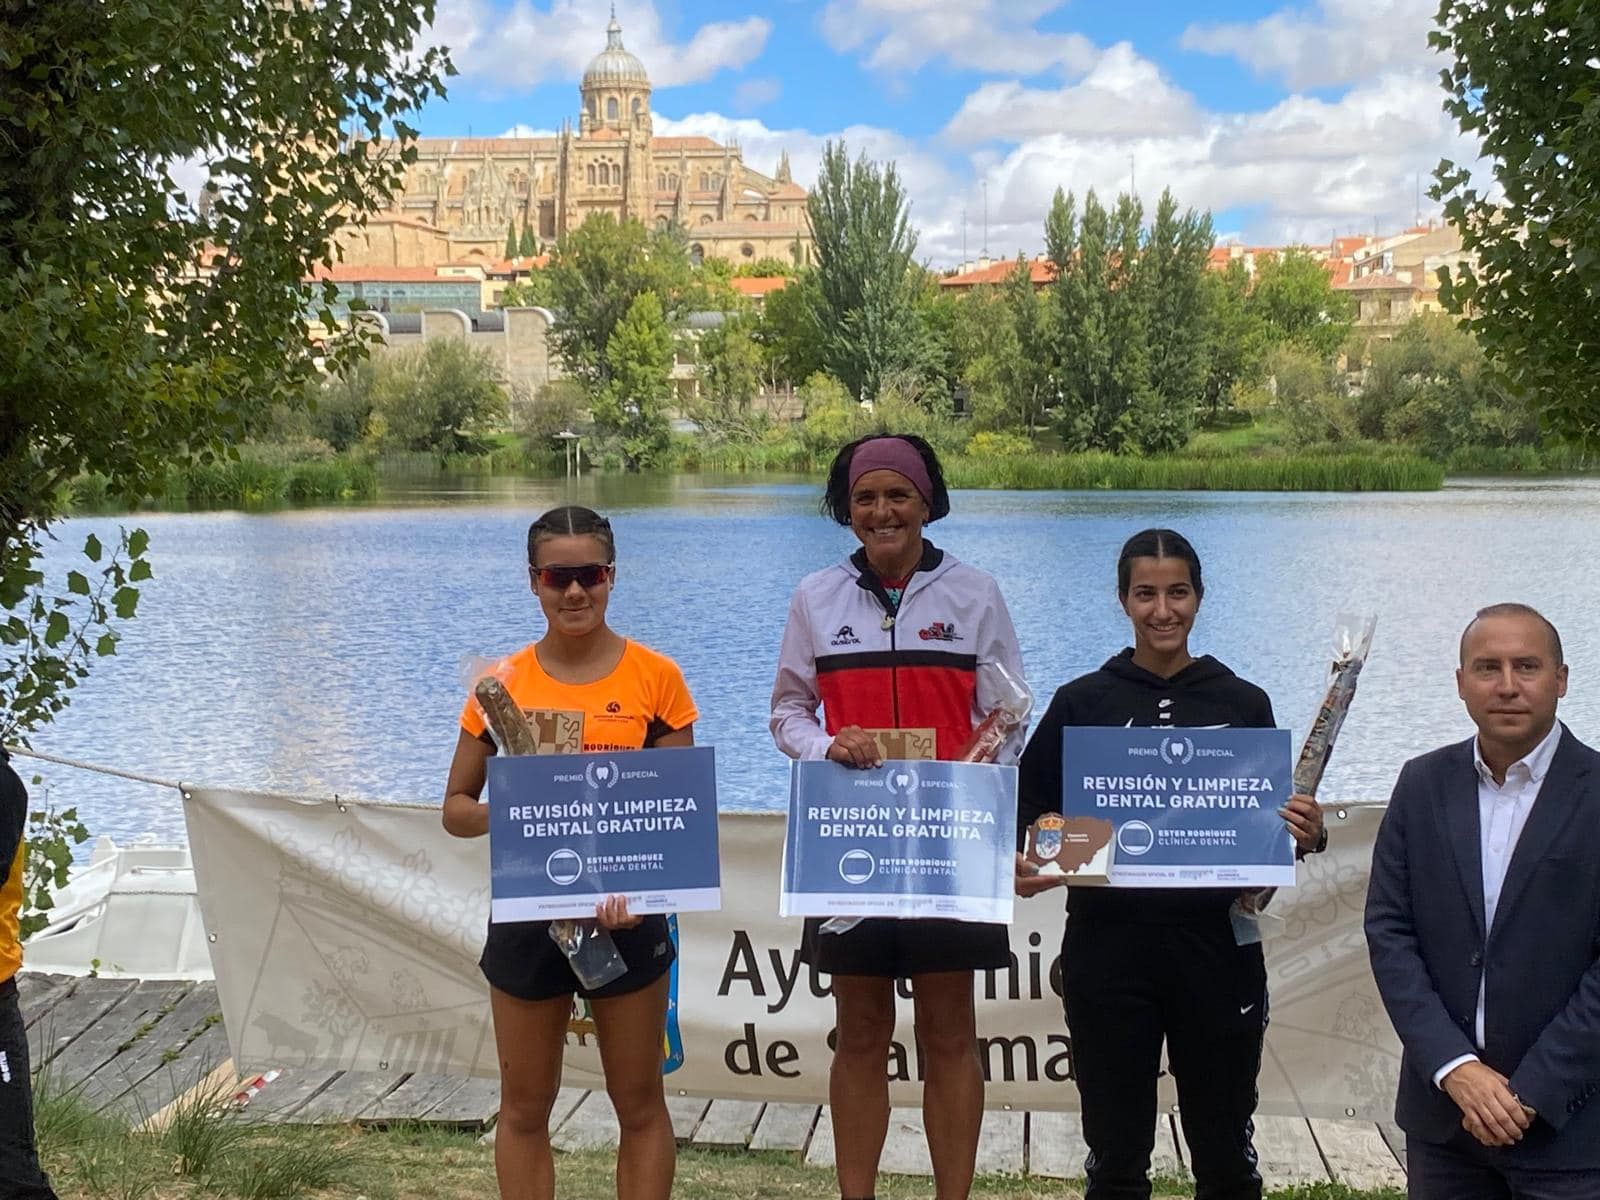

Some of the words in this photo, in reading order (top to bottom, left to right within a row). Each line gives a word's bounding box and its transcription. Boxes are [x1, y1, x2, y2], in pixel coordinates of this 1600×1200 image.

[1128, 747, 1158, 756] PREMIO
[1196, 749, 1235, 757] ESPECIAL
[553, 773, 584, 782] PREMIO
[621, 771, 659, 779] ESPECIAL
[854, 779, 883, 787] PREMIO
[1083, 774, 1167, 791] REVISIÓN
[1172, 778, 1183, 791] Y
[1187, 777, 1273, 792] LIMPIEZA
[1096, 794, 1166, 808] DENTAL
[1169, 794, 1260, 809] GRATUITA
[509, 800, 593, 820] REVISIÓN
[599, 802, 609, 816] Y
[614, 798, 697, 815] LIMPIEZA
[808, 804, 890, 821] REVISIÓN
[895, 808, 907, 820] Y
[910, 808, 995, 824] LIMPIEZA
[523, 821, 593, 838] DENTAL
[596, 816, 685, 834] GRATUITA
[820, 824, 888, 838] DENTAL
[892, 824, 981, 840] GRATUITA
[1187, 829, 1237, 838] RODRÍGUEZ
[1158, 837, 1197, 846] CLÍNICA
[1200, 838, 1237, 846] DENTAL
[587, 856, 614, 864] ESTER
[615, 853, 664, 863] RODRÍGUEZ
[879, 858, 906, 866] ESTER
[587, 862, 625, 873] CLÍNICA
[628, 862, 664, 872] DENTAL
[879, 866, 917, 875] CLÍNICA
[920, 867, 957, 876] DENTAL
[724, 1023, 801, 1078] de
